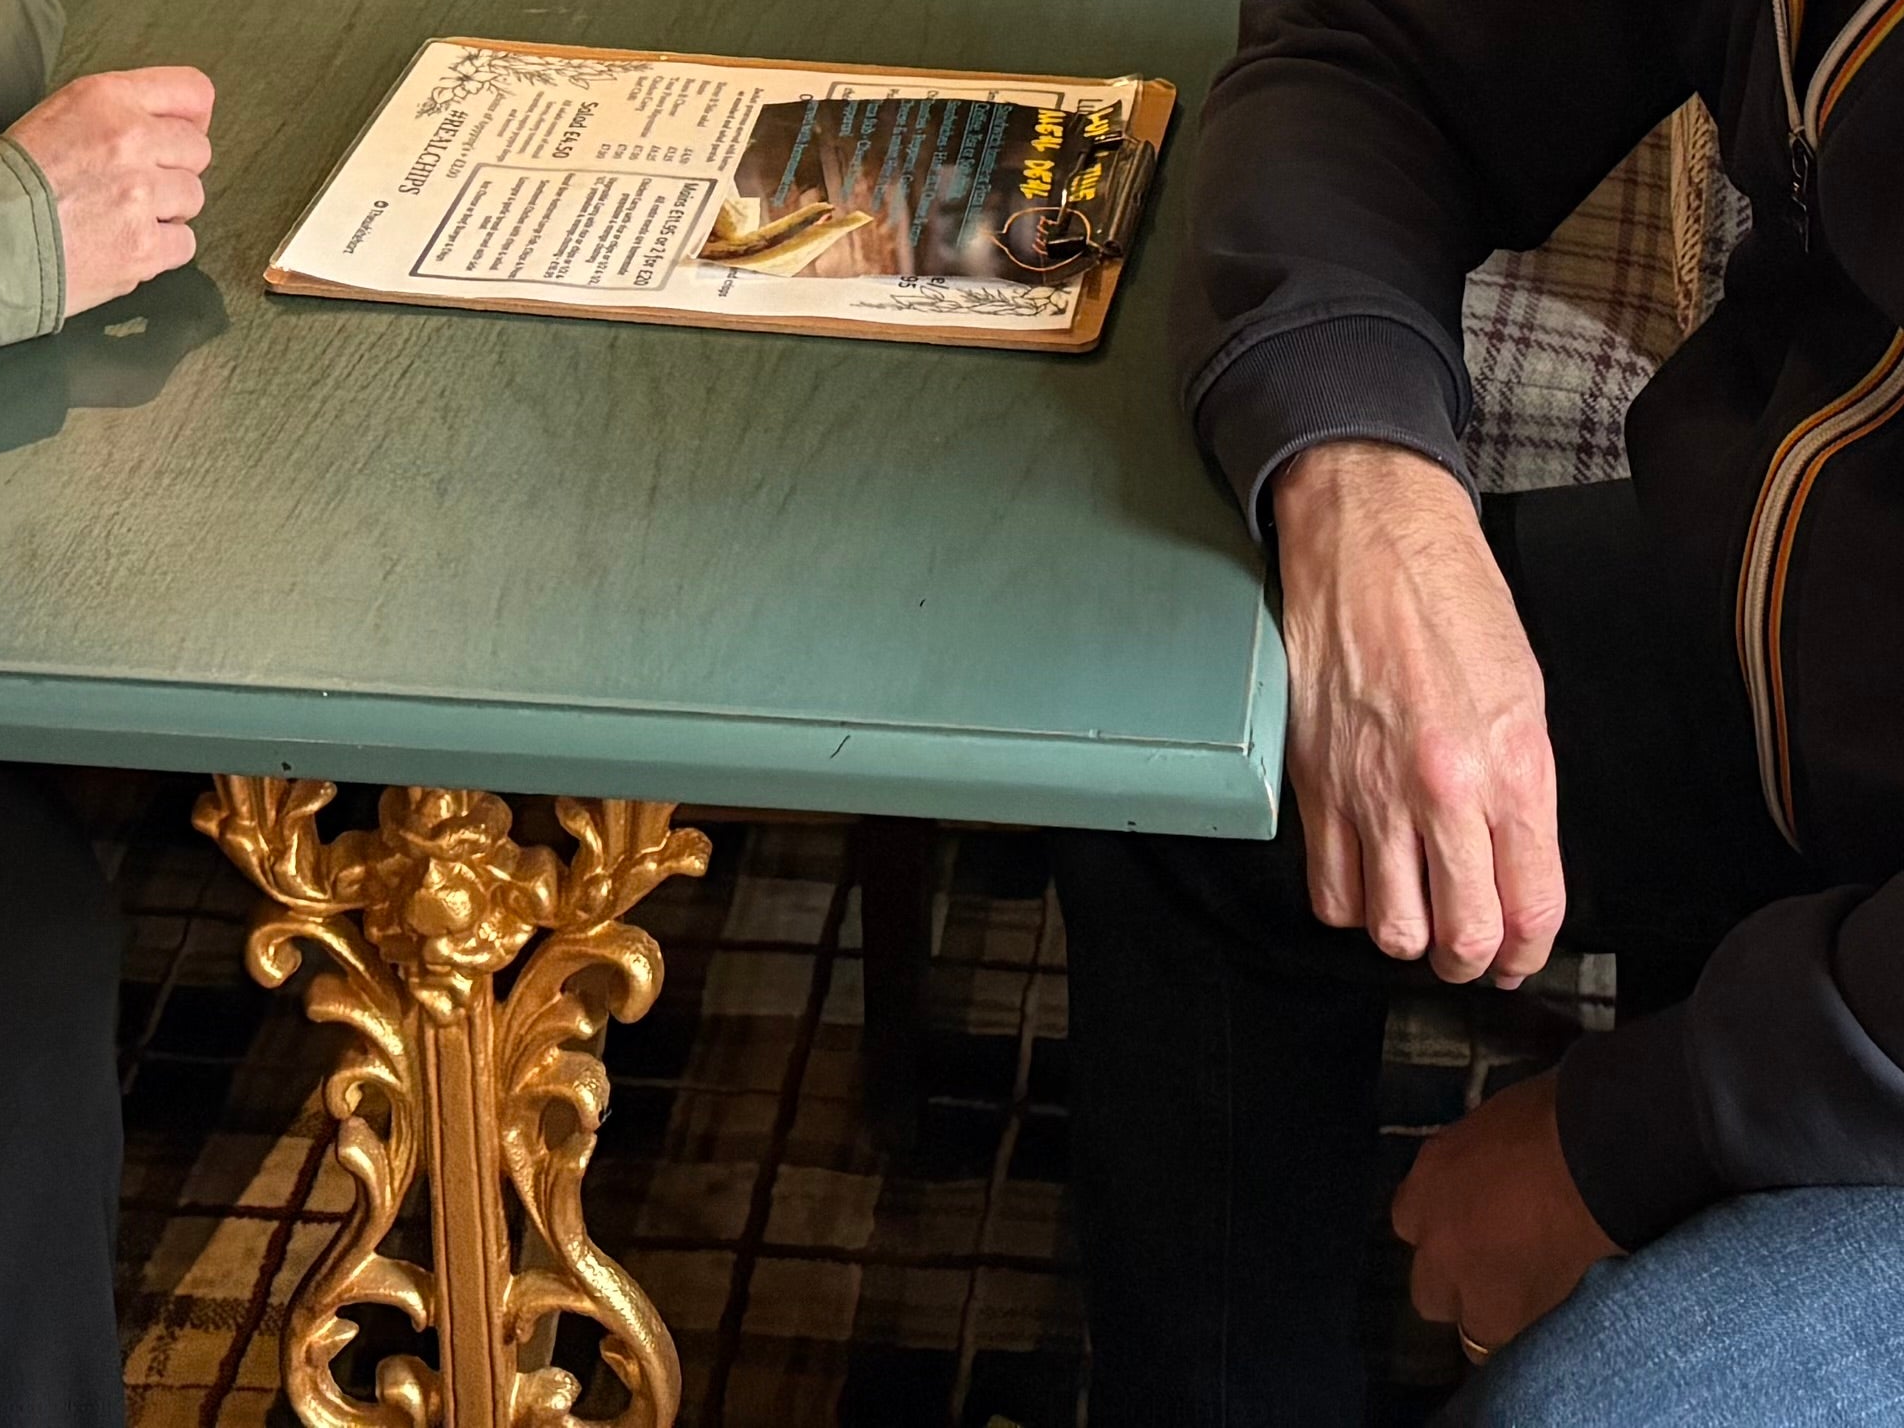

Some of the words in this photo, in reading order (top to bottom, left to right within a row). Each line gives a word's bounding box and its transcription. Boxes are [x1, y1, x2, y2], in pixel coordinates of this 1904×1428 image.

[569, 102, 599, 128] Salad
[1032, 109, 1065, 152] MEAL
[398, 110, 468, 195] #REALCHIPS
[552, 131, 581, 158] £4.50
[1021, 159, 1054, 199] DEAL
[674, 183, 699, 207] Mains
[660, 210, 684, 235] £11.95
[654, 237, 669, 246] or
[643, 255, 663, 267] for
[633, 270, 653, 286] £20
